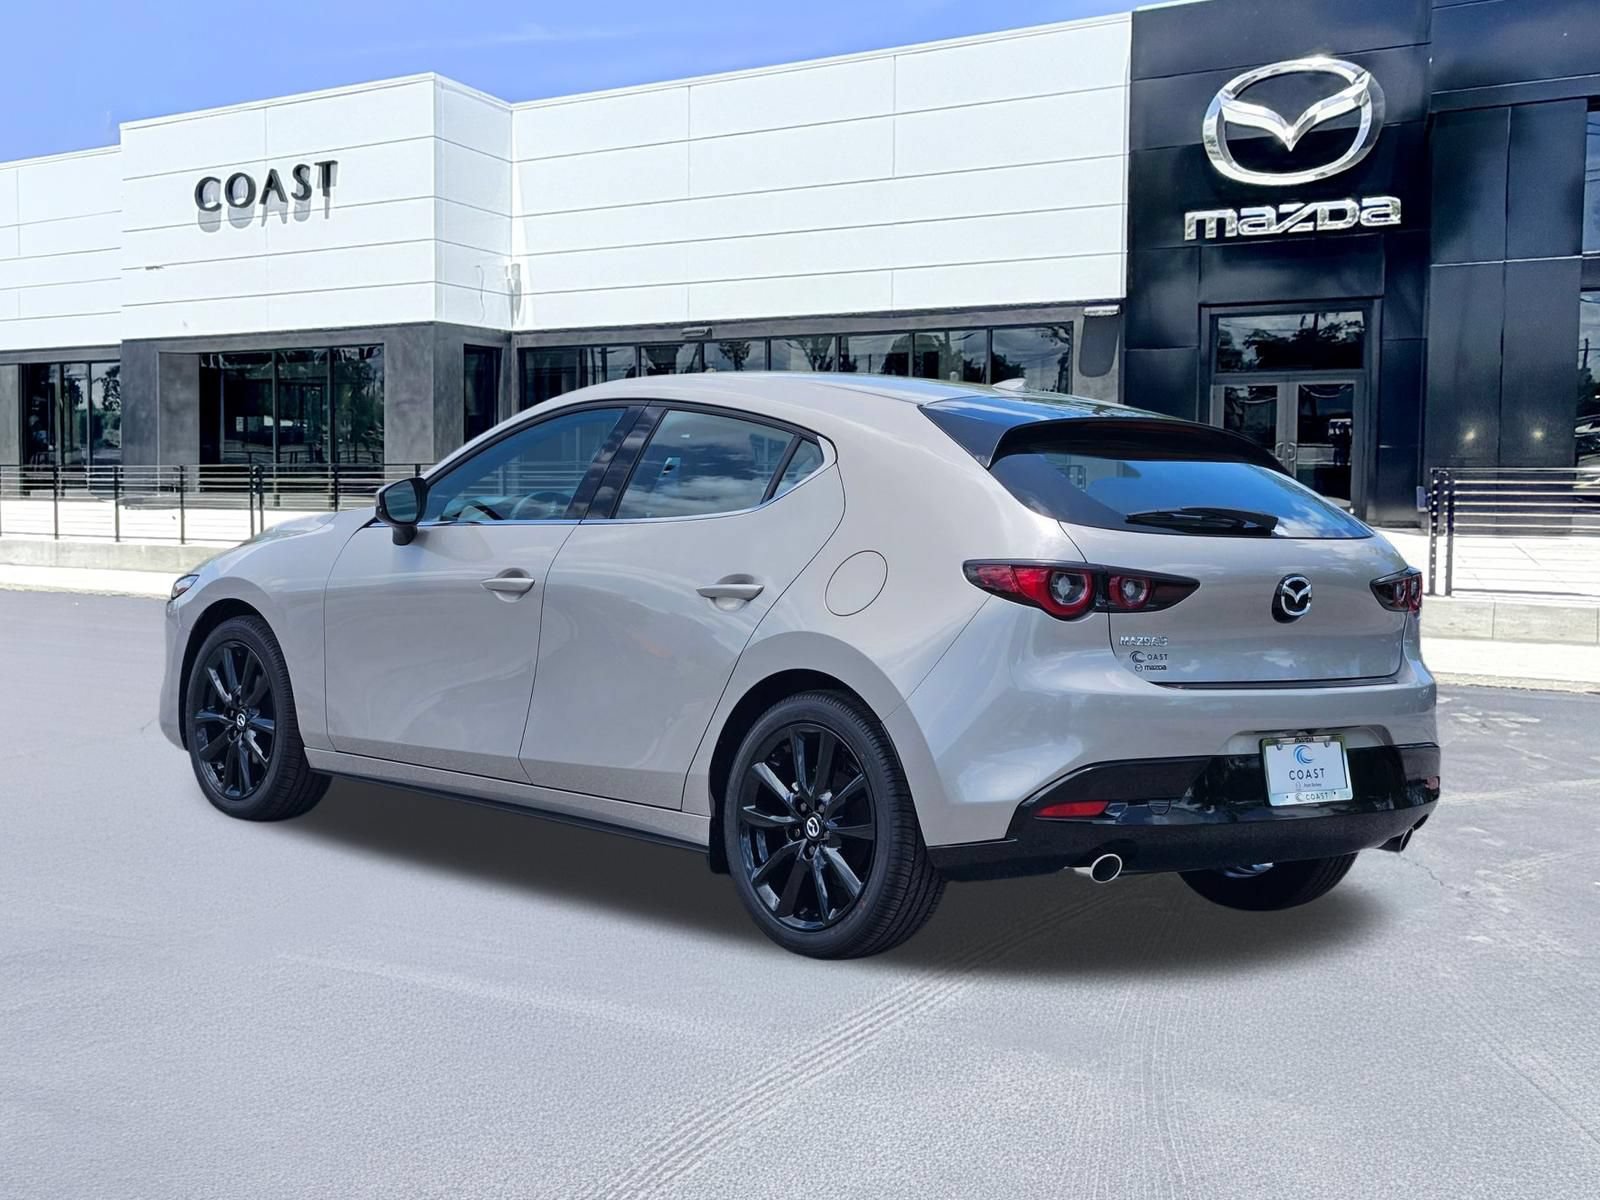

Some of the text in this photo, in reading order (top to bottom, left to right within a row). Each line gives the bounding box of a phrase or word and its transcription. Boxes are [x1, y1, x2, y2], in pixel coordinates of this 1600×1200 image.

[194, 160, 338, 212] COAST
[1289, 768, 1325, 780] COAST
[1306, 792, 1328, 801] COAST
